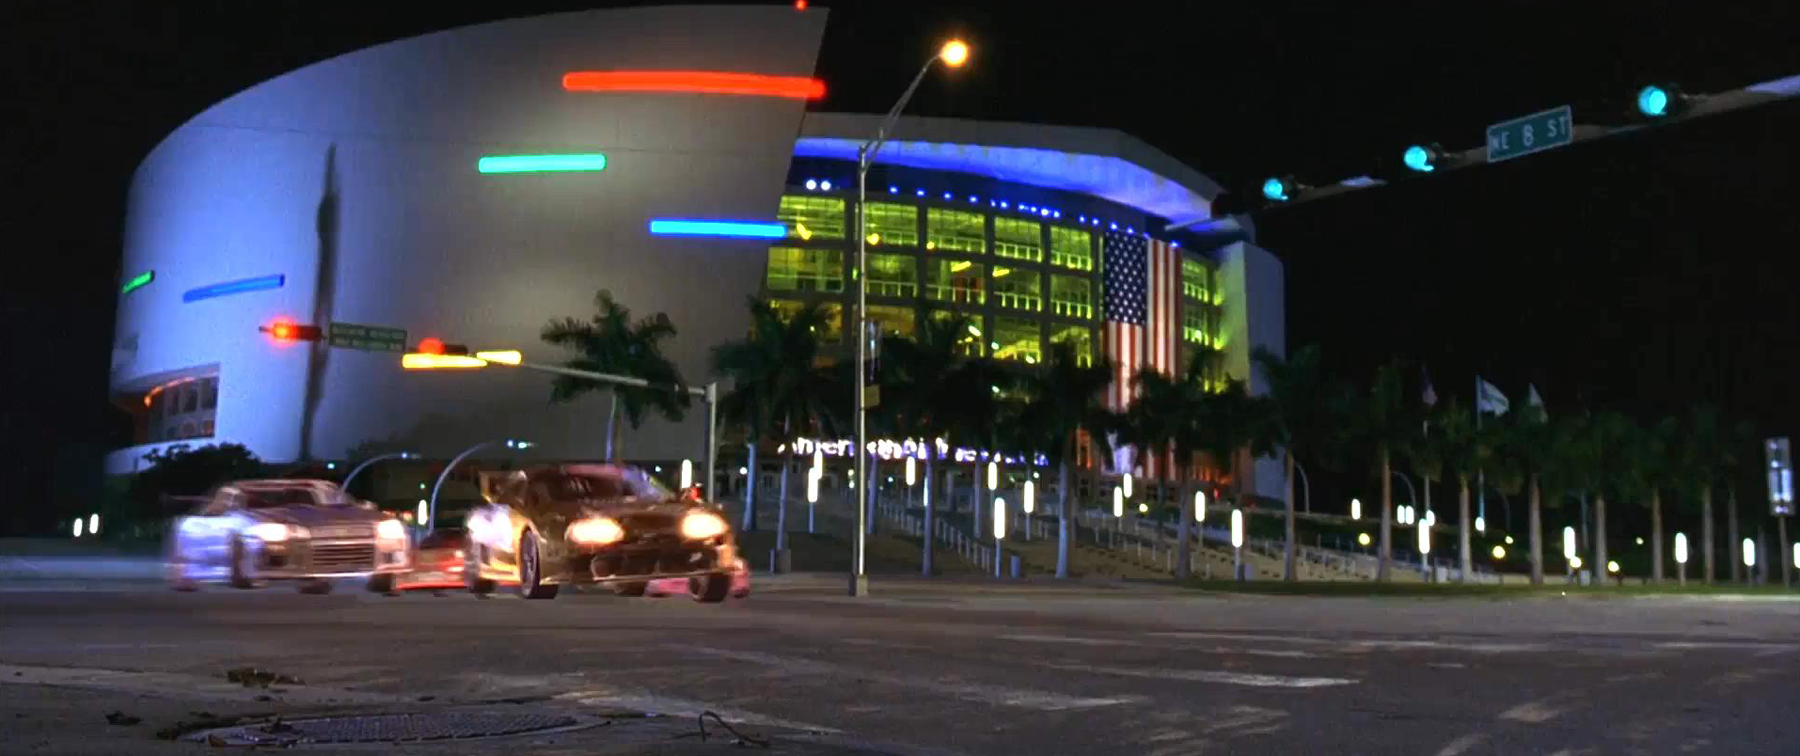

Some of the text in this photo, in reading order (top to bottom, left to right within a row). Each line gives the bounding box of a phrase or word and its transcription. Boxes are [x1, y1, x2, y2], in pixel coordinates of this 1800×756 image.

[1491, 116, 1565, 151] NE 8 ST
